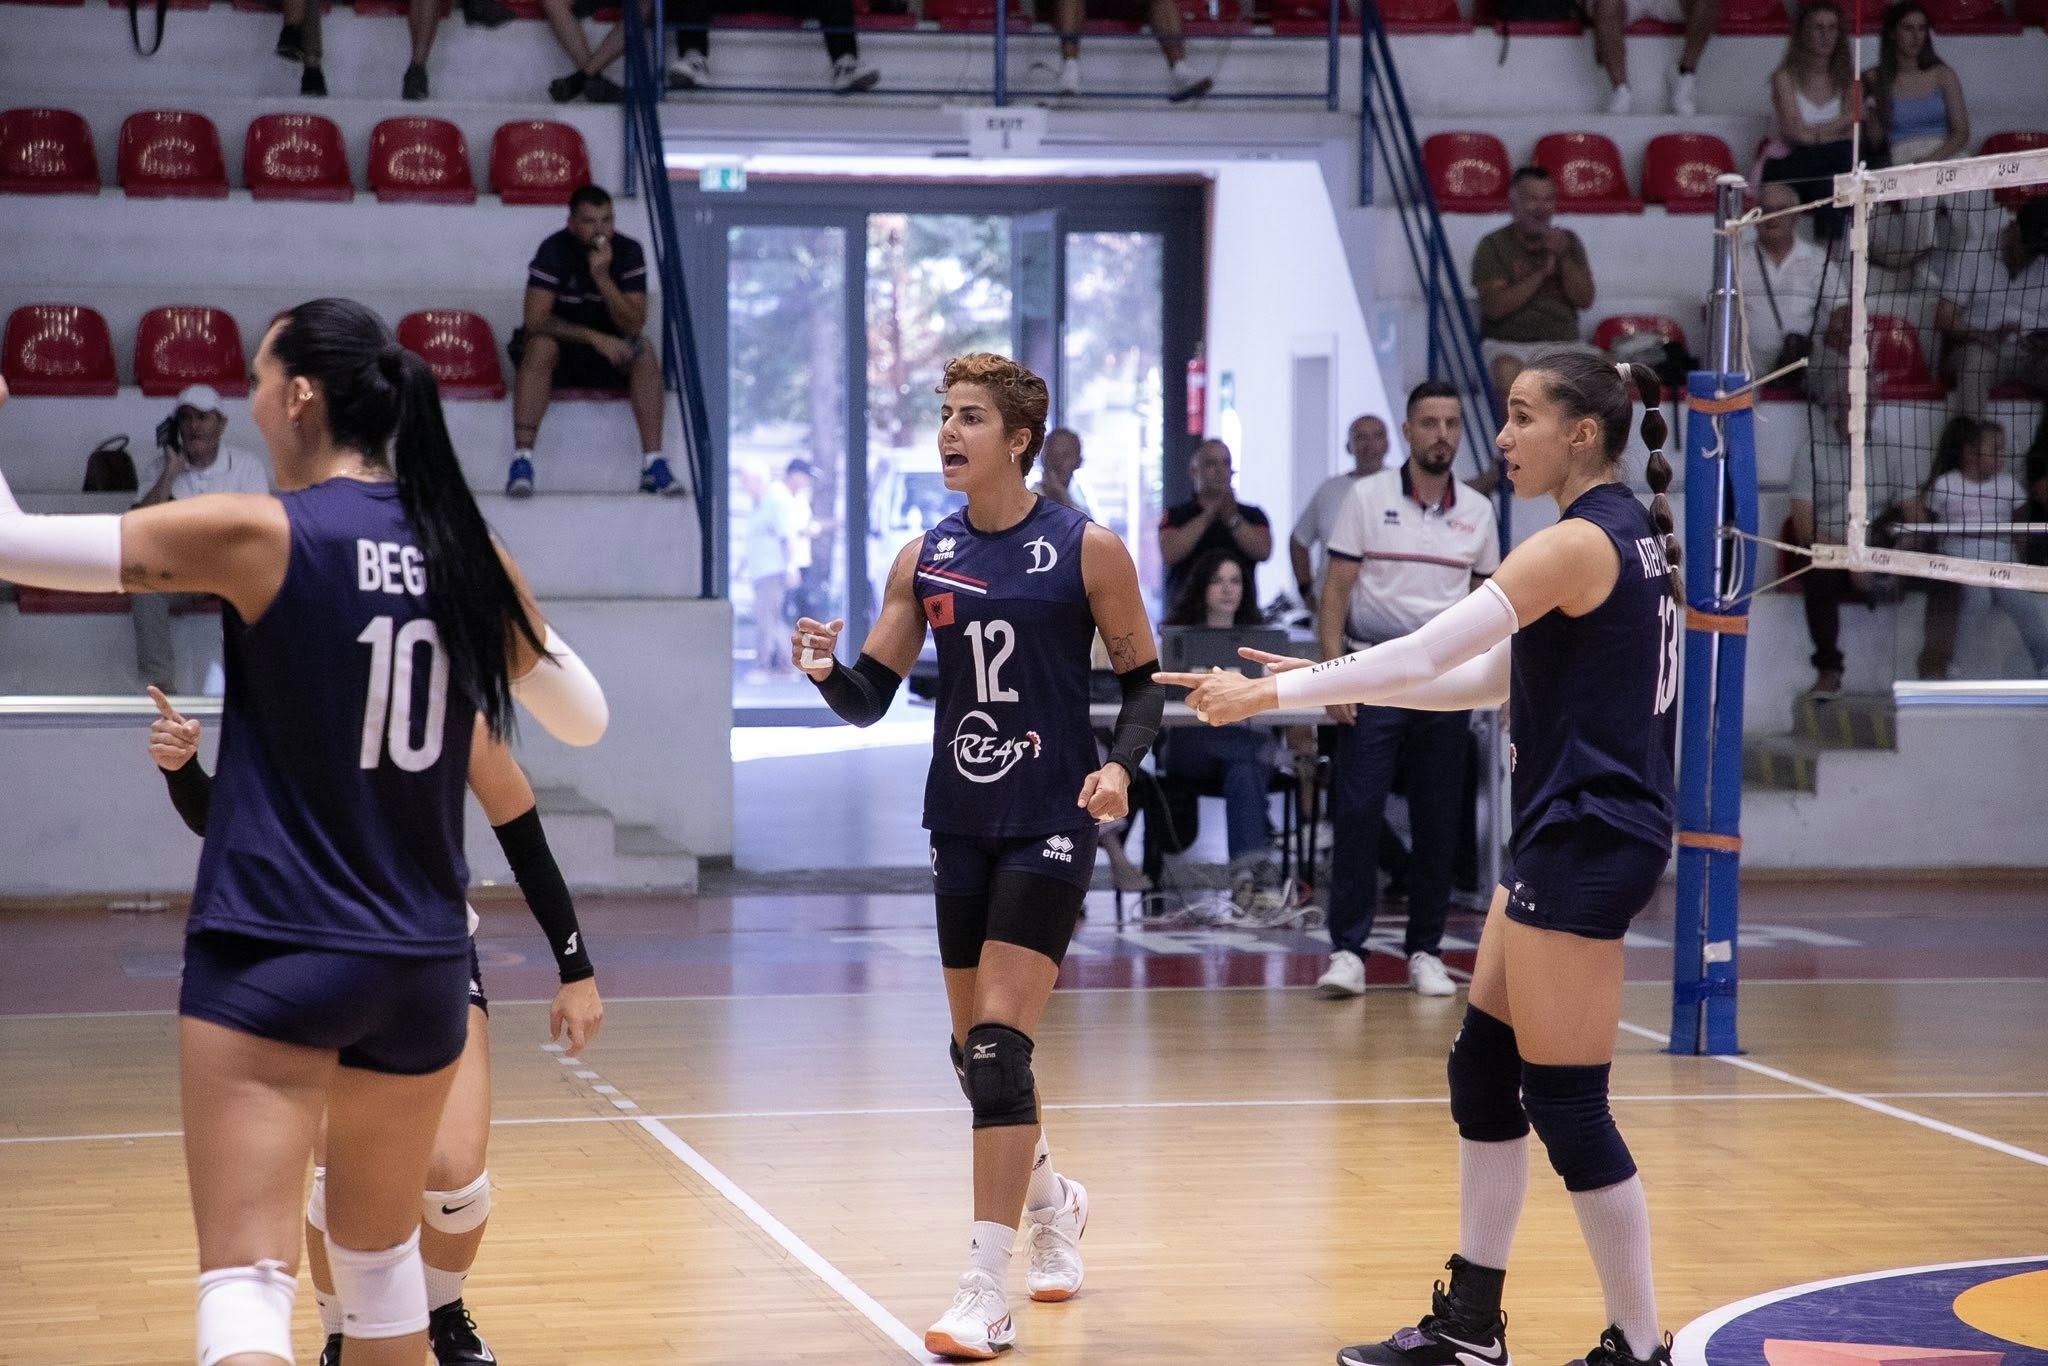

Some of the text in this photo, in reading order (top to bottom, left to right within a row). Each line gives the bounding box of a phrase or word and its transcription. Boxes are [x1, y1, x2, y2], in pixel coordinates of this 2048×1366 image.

[987, 117, 1023, 130] EXIT
[933, 550, 955, 561] errea
[963, 619, 1020, 703] 12
[1311, 655, 1357, 674] KIPSTA
[1653, 595, 1678, 715] 13
[356, 615, 450, 772] 10
[1042, 848, 1072, 863] errea
